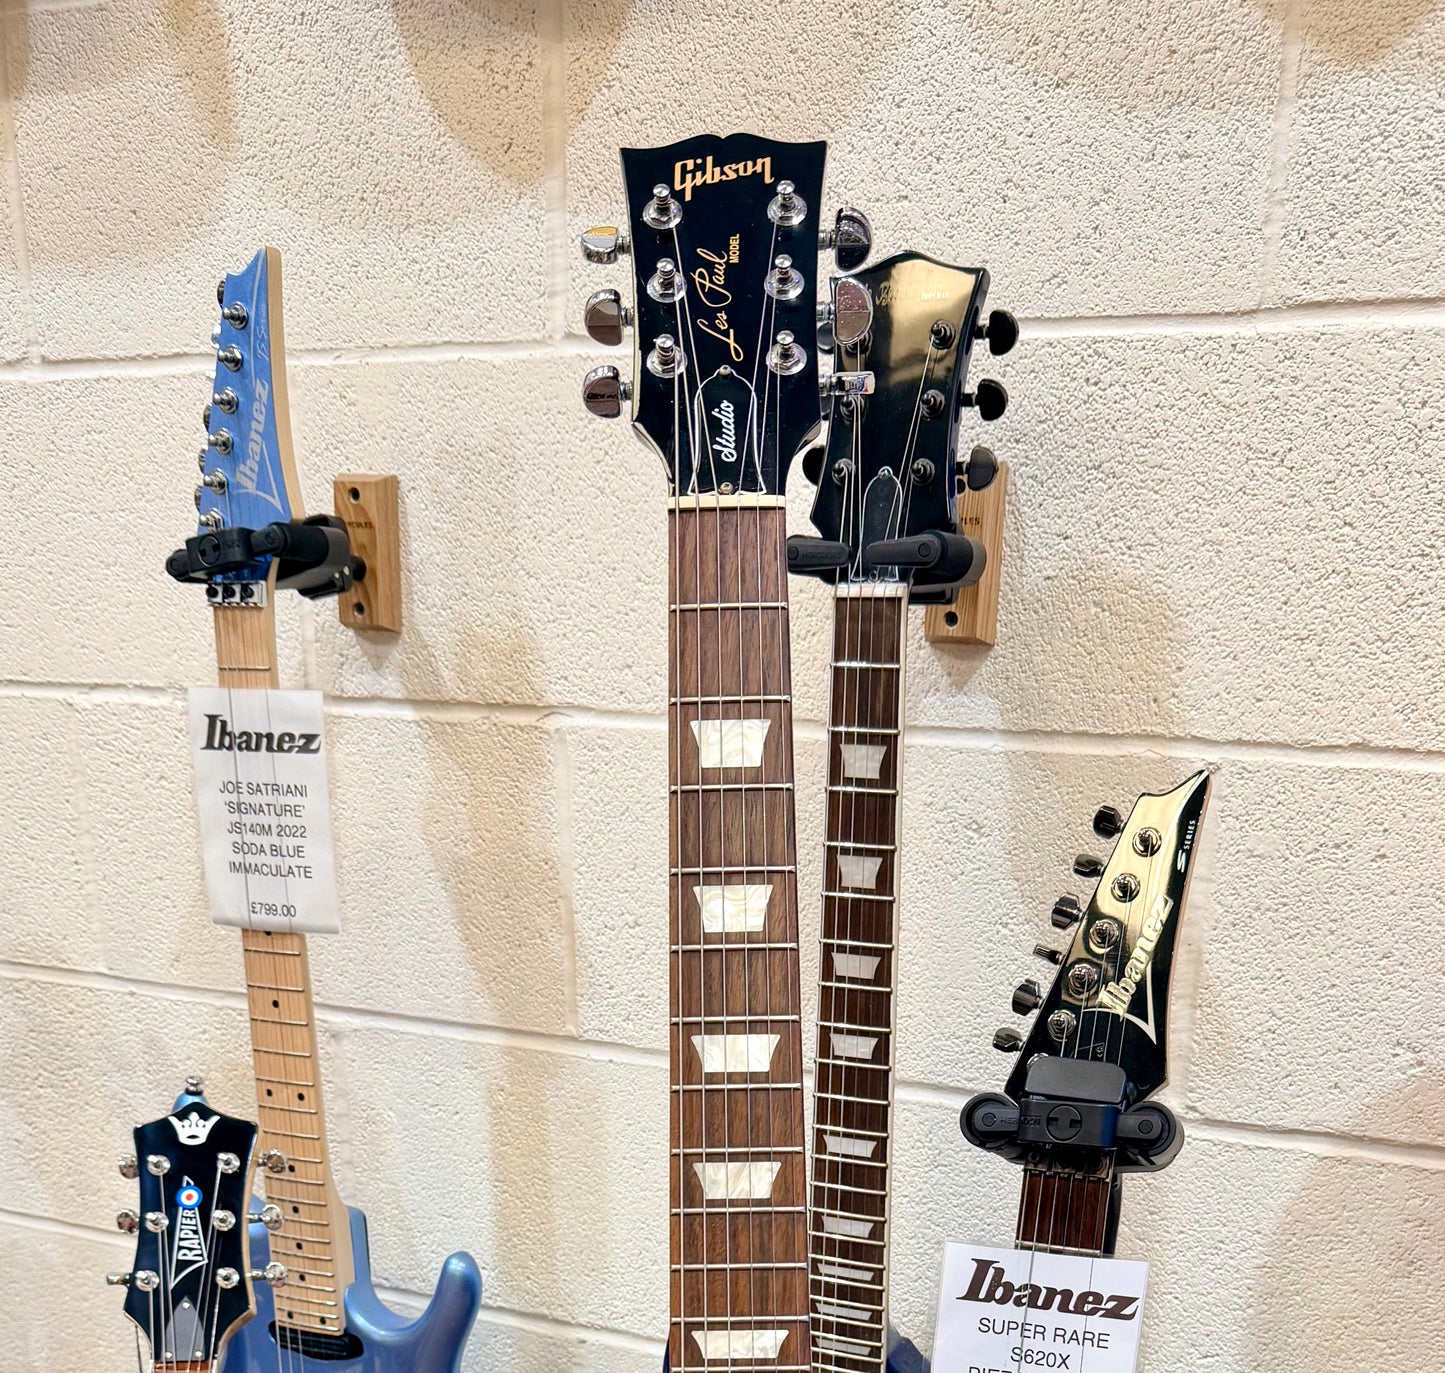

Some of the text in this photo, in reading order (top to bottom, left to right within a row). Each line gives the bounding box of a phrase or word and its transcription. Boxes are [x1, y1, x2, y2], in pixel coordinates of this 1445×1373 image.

[673, 155, 775, 201] Gibson
[729, 234, 740, 264] MODEL
[690, 247, 744, 363] Les Paul
[236, 379, 269, 495] Ibanez
[712, 400, 735, 462] Studio
[200, 714, 321, 754] Ibanez
[219, 781, 308, 798] JOE SATRIANI
[227, 822, 307, 838] JS140M 2022
[1183, 820, 1196, 850] SERIES
[232, 842, 306, 859] SODA BLUE
[229, 861, 313, 879] IMMACULATE
[251, 902, 297, 918] £799.00
[1098, 895, 1174, 1020] Ibanez
[178, 1209, 203, 1260] RAPIER
[955, 1258, 1141, 1321] Ibanez
[978, 1317, 1111, 1350] SUPER RARE
[1010, 1347, 1070, 1370] S620X
